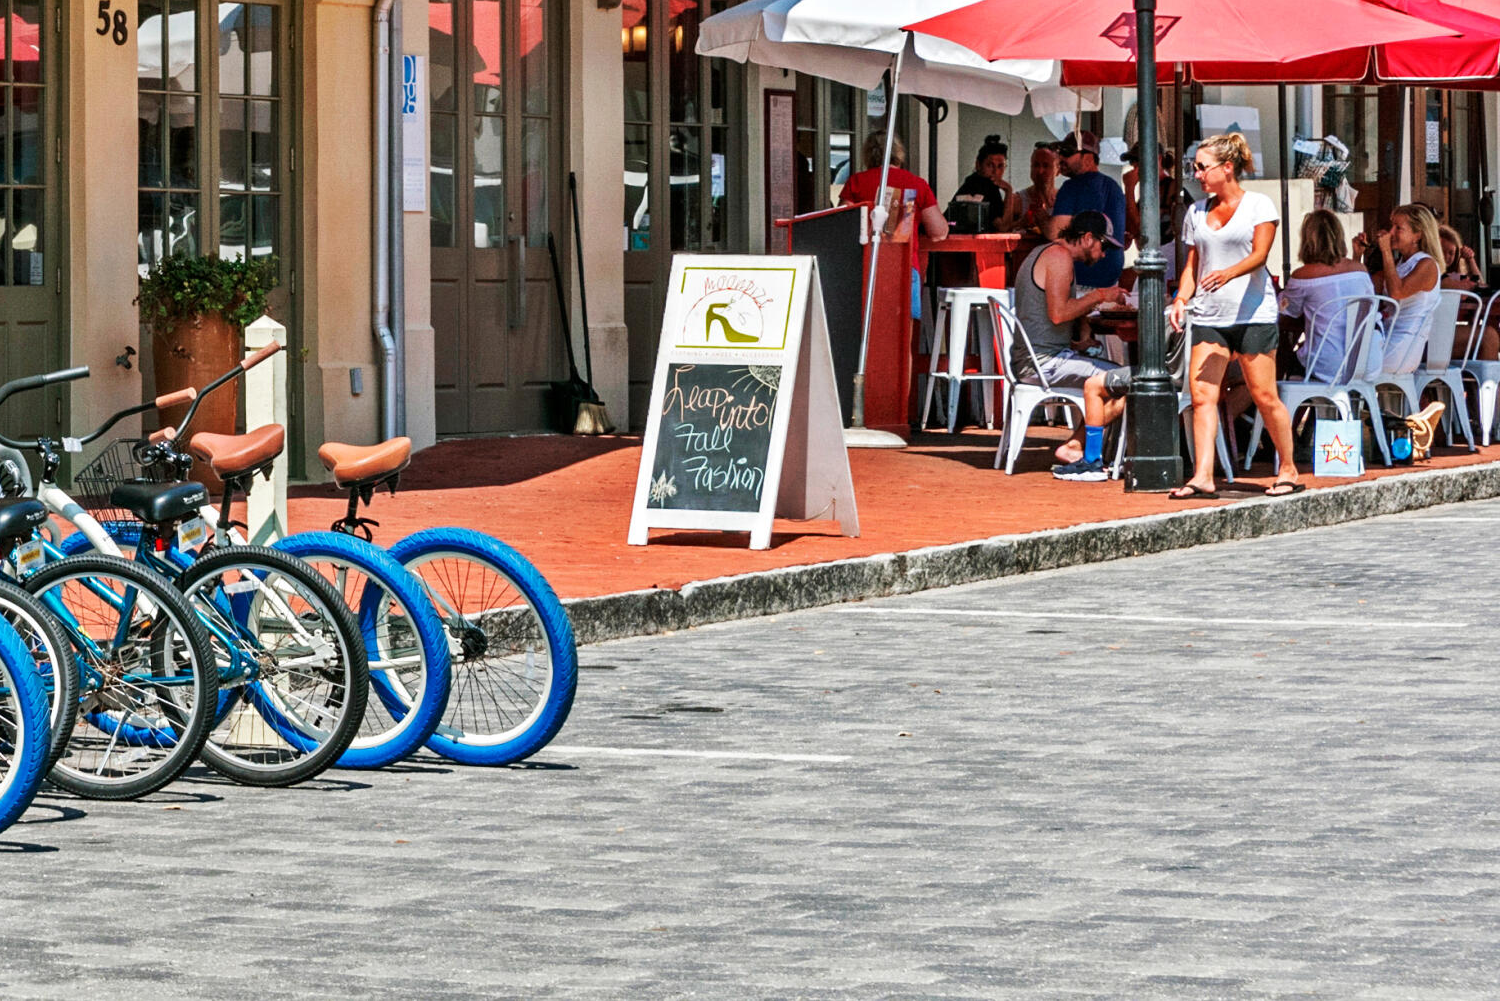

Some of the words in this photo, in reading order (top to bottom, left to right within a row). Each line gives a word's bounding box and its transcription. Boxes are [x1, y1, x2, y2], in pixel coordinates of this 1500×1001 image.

[96, 0, 128, 45] 58
[719, 395, 770, 431] into
[674, 423, 733, 453] Fall
[681, 456, 764, 501] Fashion
